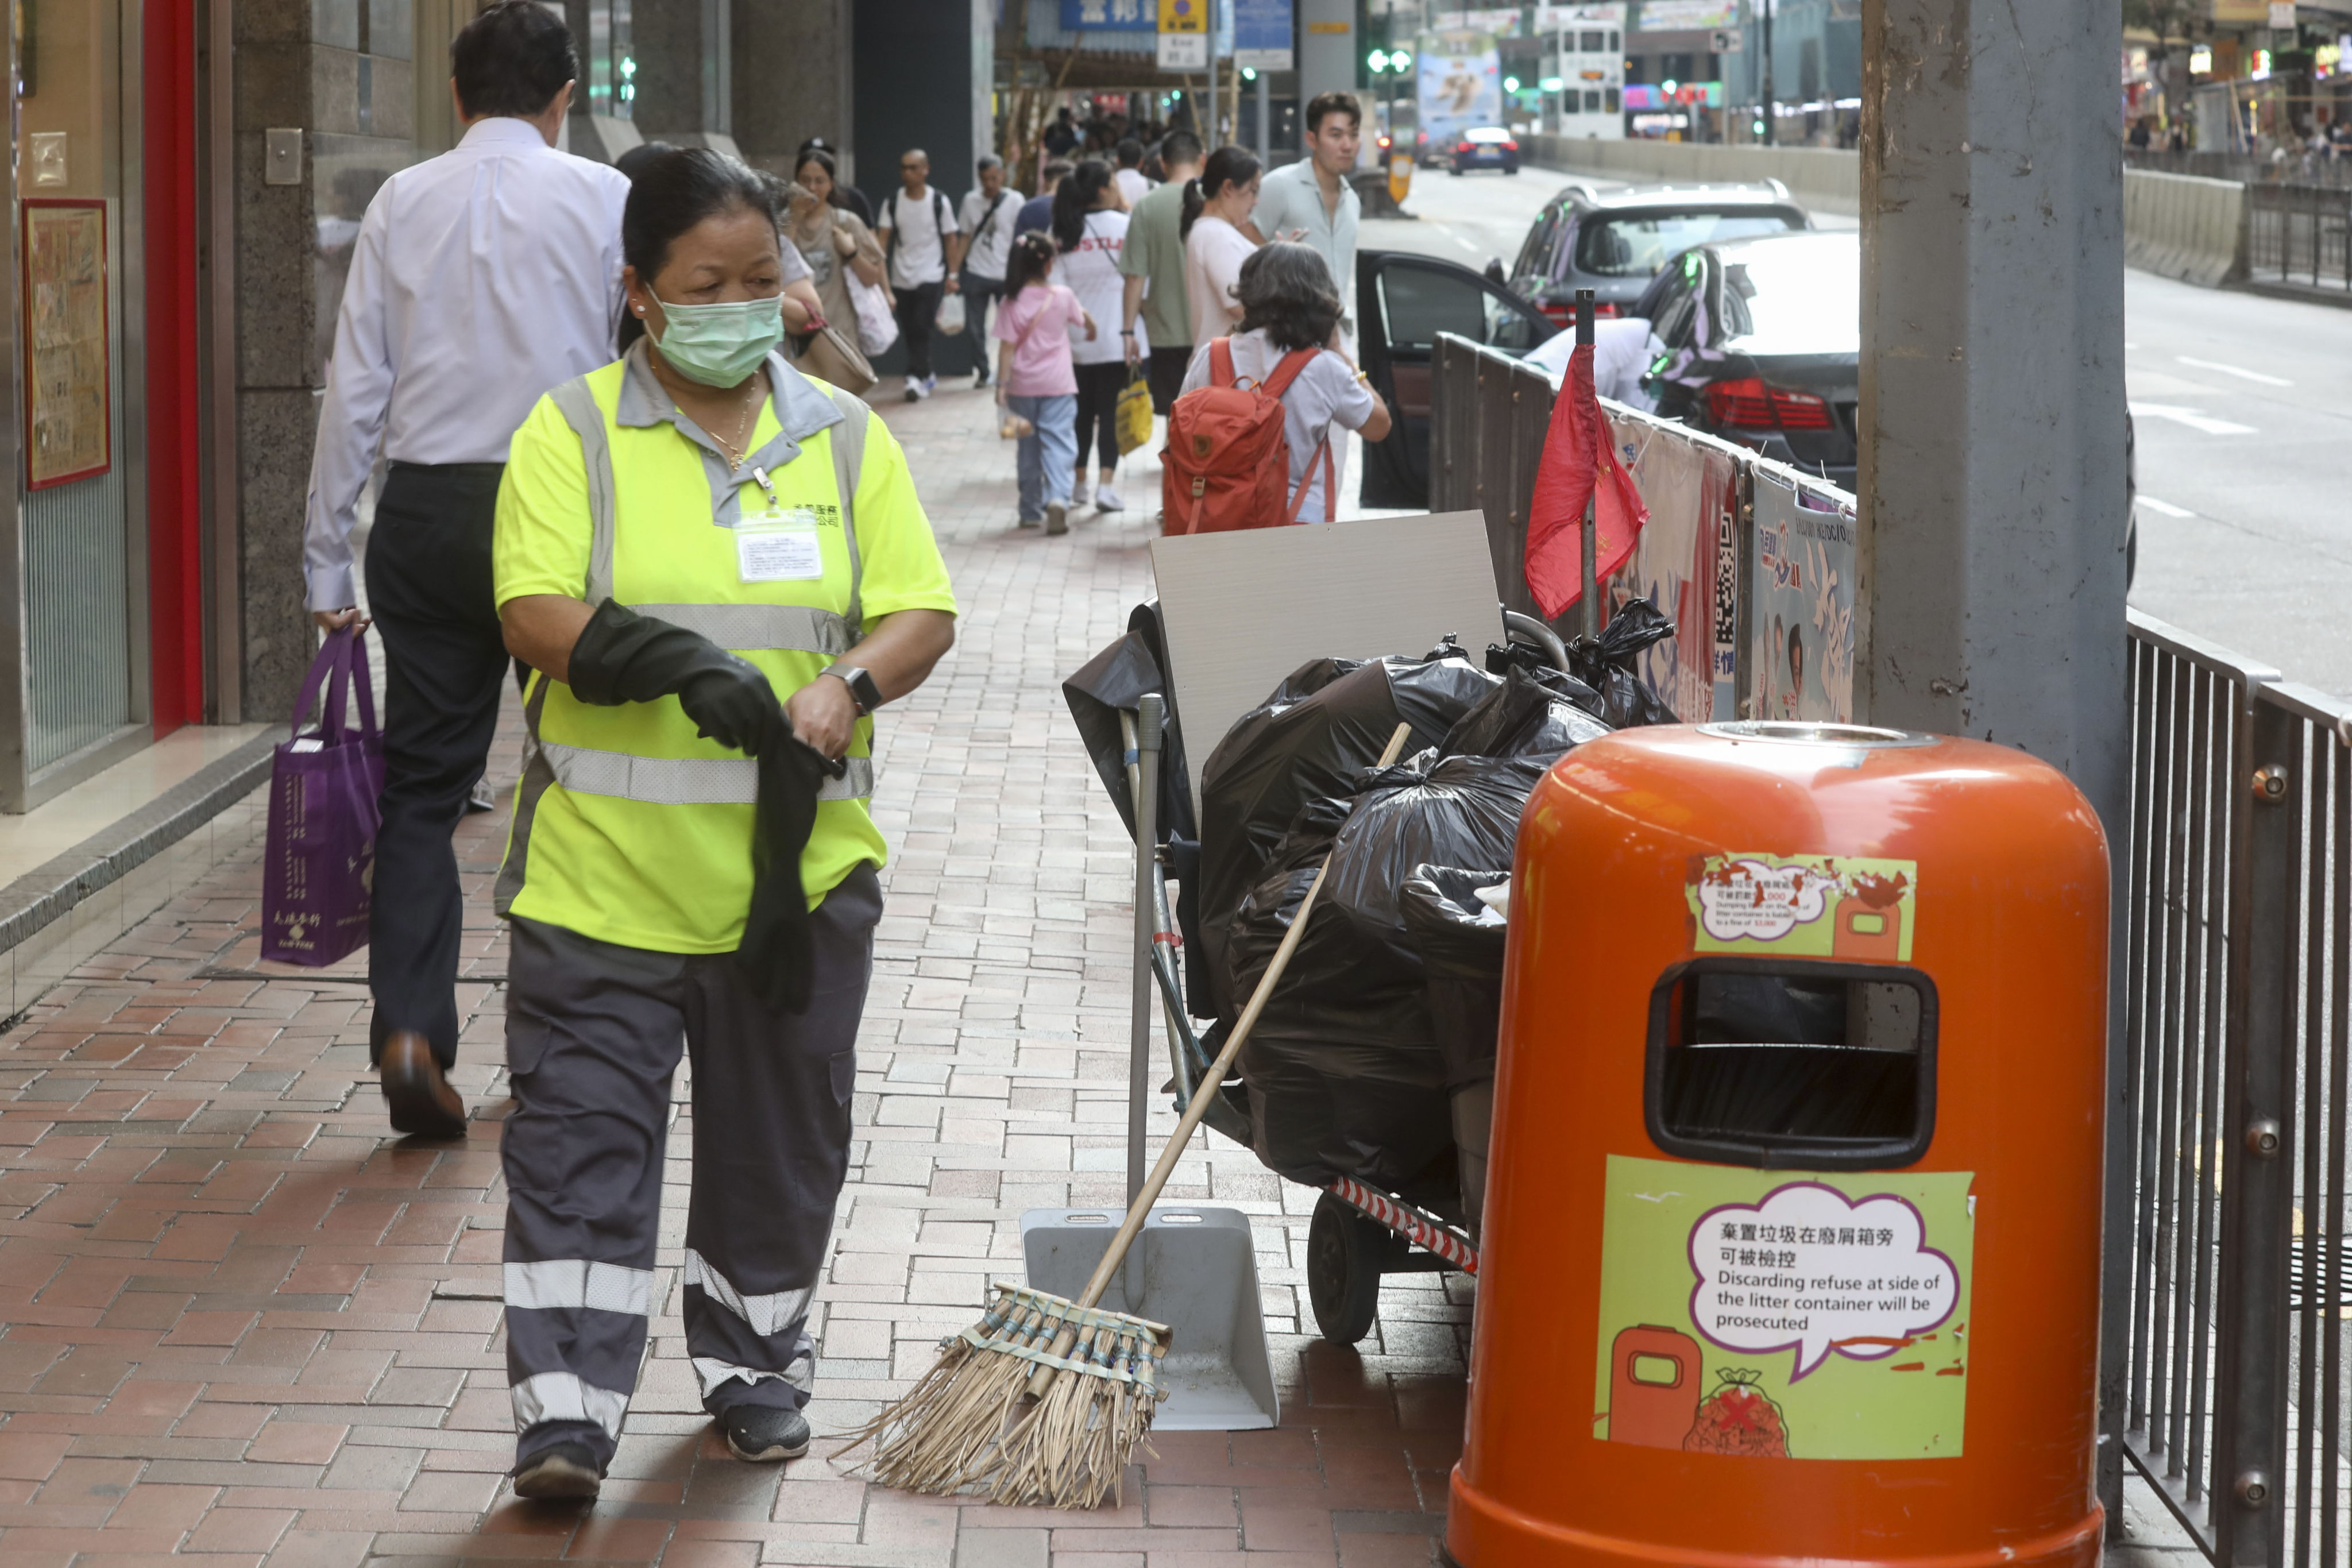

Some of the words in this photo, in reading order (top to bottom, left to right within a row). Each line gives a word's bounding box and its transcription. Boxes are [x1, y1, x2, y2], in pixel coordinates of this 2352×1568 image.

[1721, 1222, 1894, 1247] 棄置垃圾在廢屑箱旁
[1720, 1247, 1797, 1269] 可被檢控
[1718, 1270, 1805, 1292] Discarding
[1811, 1276, 1861, 1290] refuse
[1867, 1278, 1883, 1290] at
[1888, 1276, 1919, 1290] side
[1924, 1275, 1941, 1289] of
[1717, 1292, 1744, 1306] the
[1749, 1293, 1789, 1308] litter
[1794, 1296, 1874, 1311] container
[1878, 1296, 1906, 1311] will
[1911, 1296, 1930, 1311] be
[1716, 1315, 1809, 1330] prosecuted
